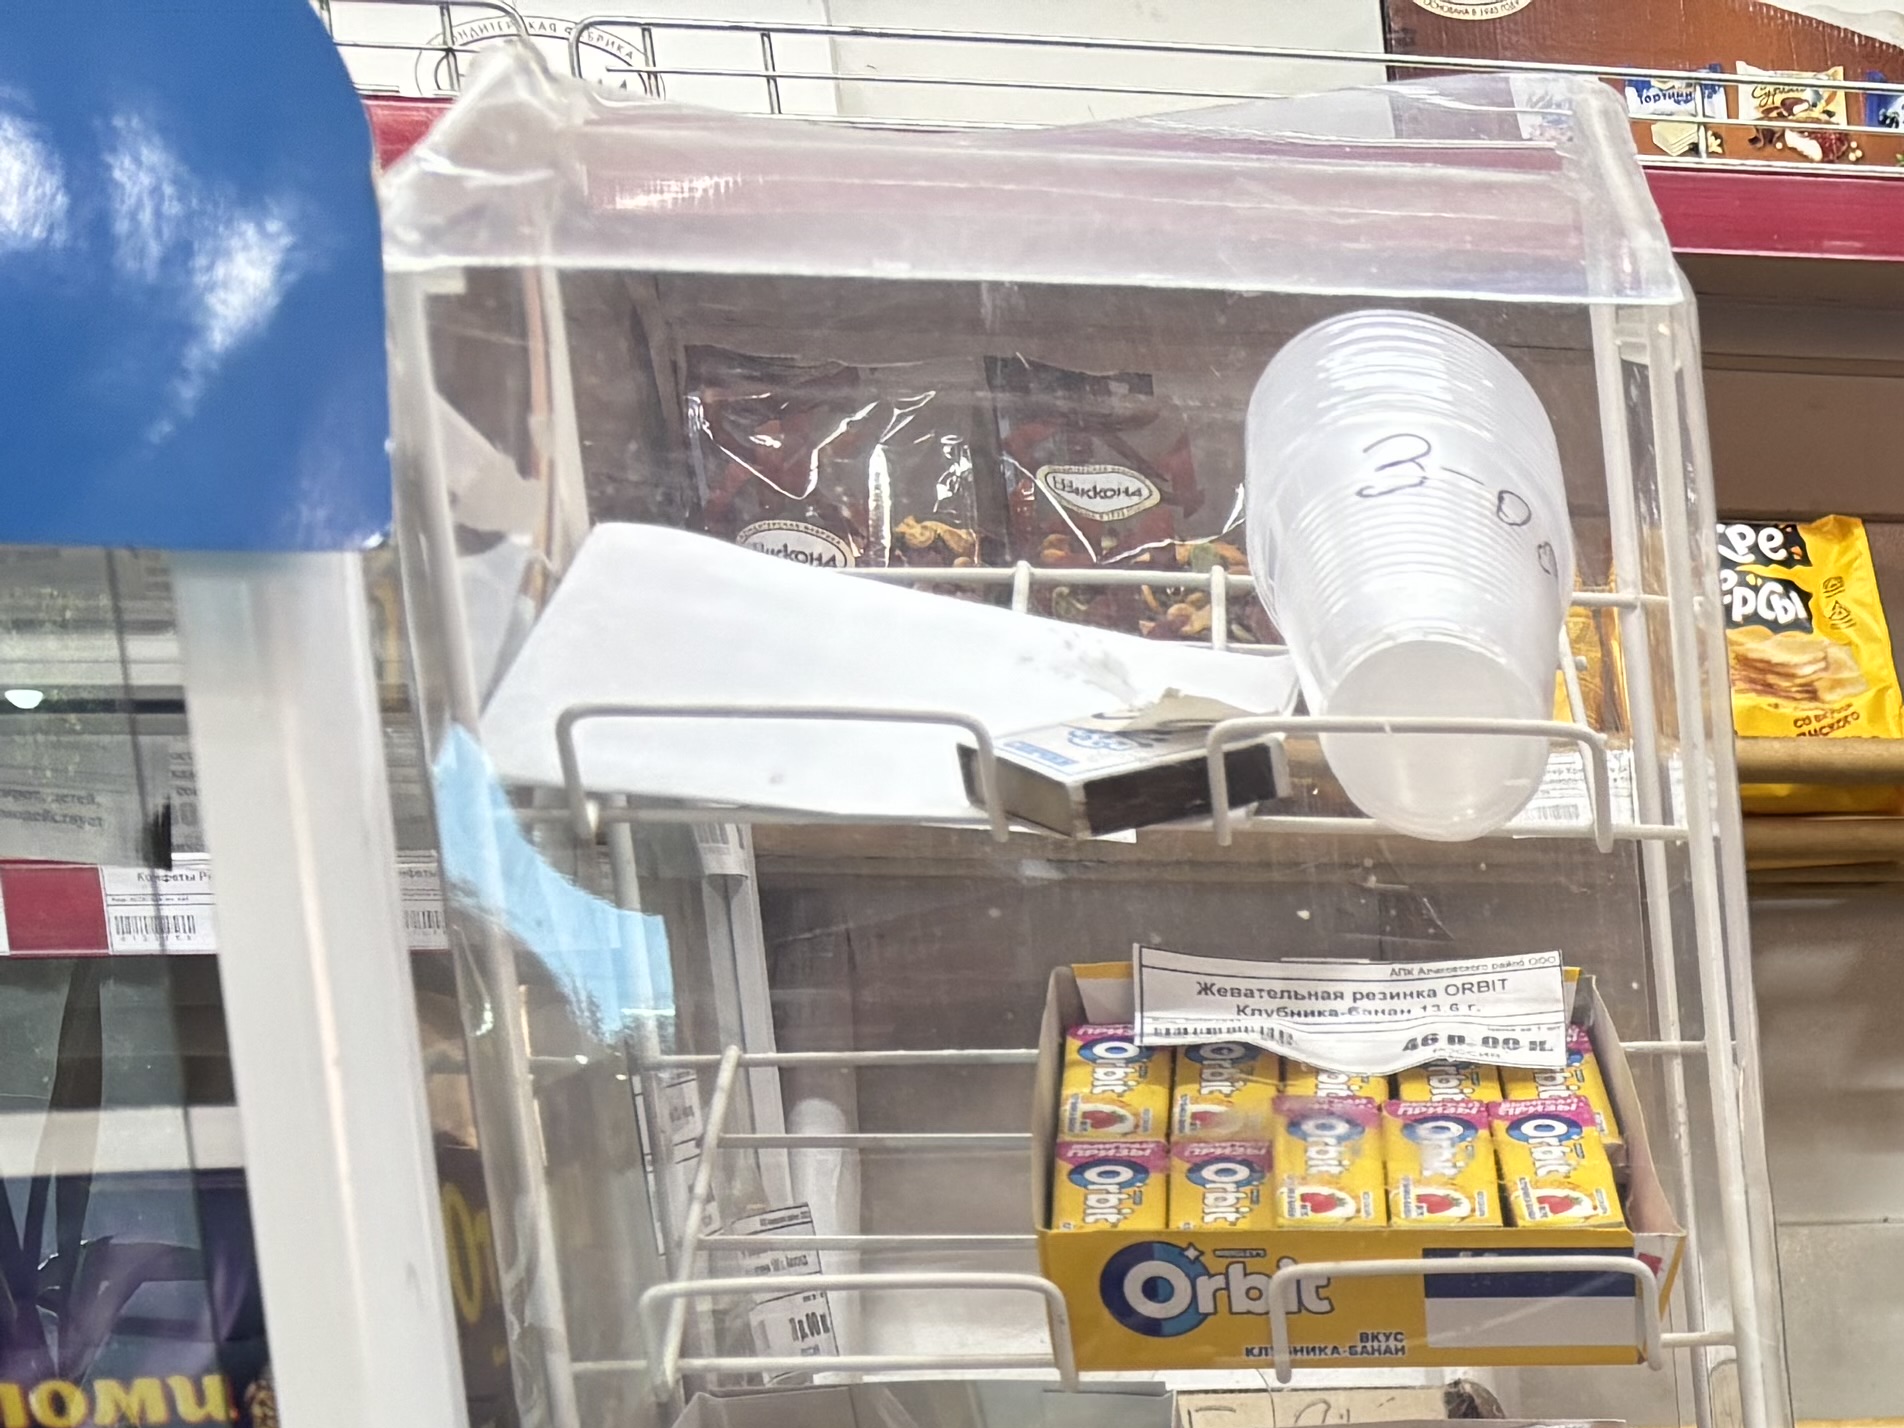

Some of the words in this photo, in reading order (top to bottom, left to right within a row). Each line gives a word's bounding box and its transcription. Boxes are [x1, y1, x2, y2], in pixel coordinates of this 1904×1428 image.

[1196, 981, 1344, 1001] Жевательная
[1352, 989, 1437, 1003] резинка
[1444, 978, 1508, 997] ORBIT
[1236, 1003, 1412, 1018] Клубника-банан
[1359, 1331, 1405, 1344] ВКУС
